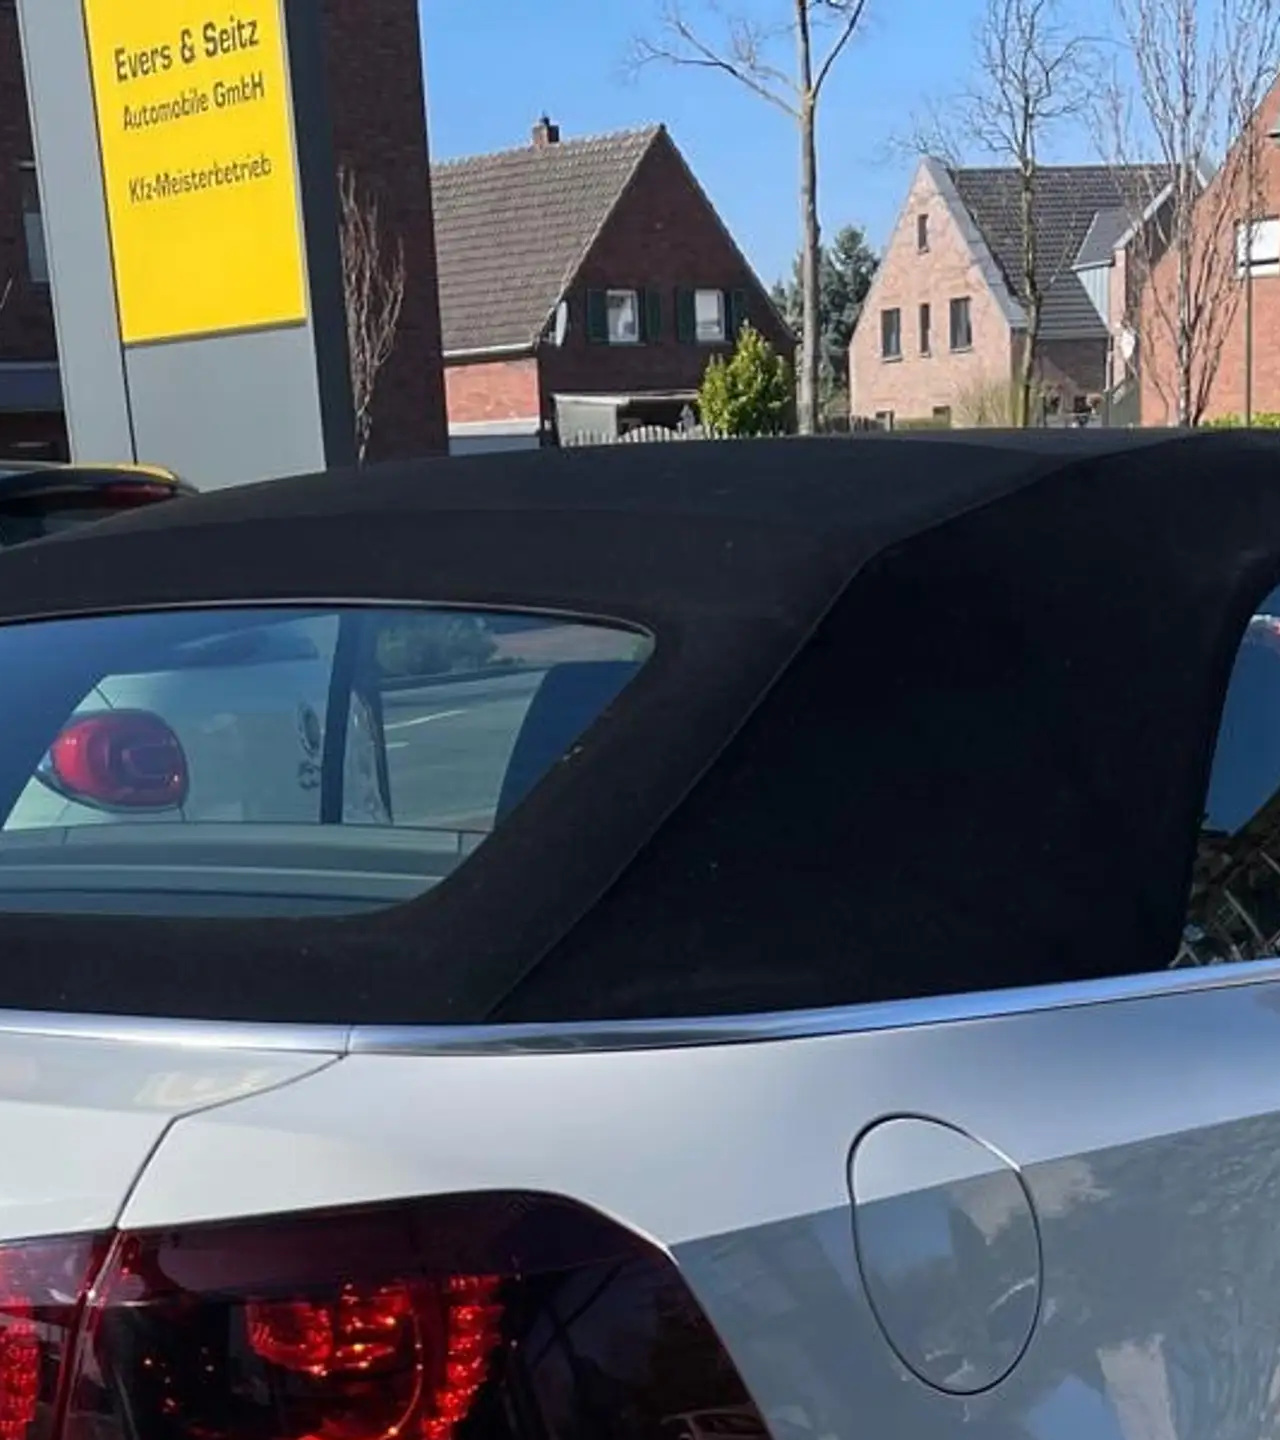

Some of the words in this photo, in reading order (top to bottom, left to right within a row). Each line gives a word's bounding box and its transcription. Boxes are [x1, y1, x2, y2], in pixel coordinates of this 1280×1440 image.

[114, 45, 173, 83] Evers
[180, 28, 196, 64] &
[203, 14, 260, 58] Seitz
[123, 88, 209, 131] Automobile
[213, 70, 265, 109] GmbH
[129, 153, 272, 204] Kfz-Meisterbetrieb
